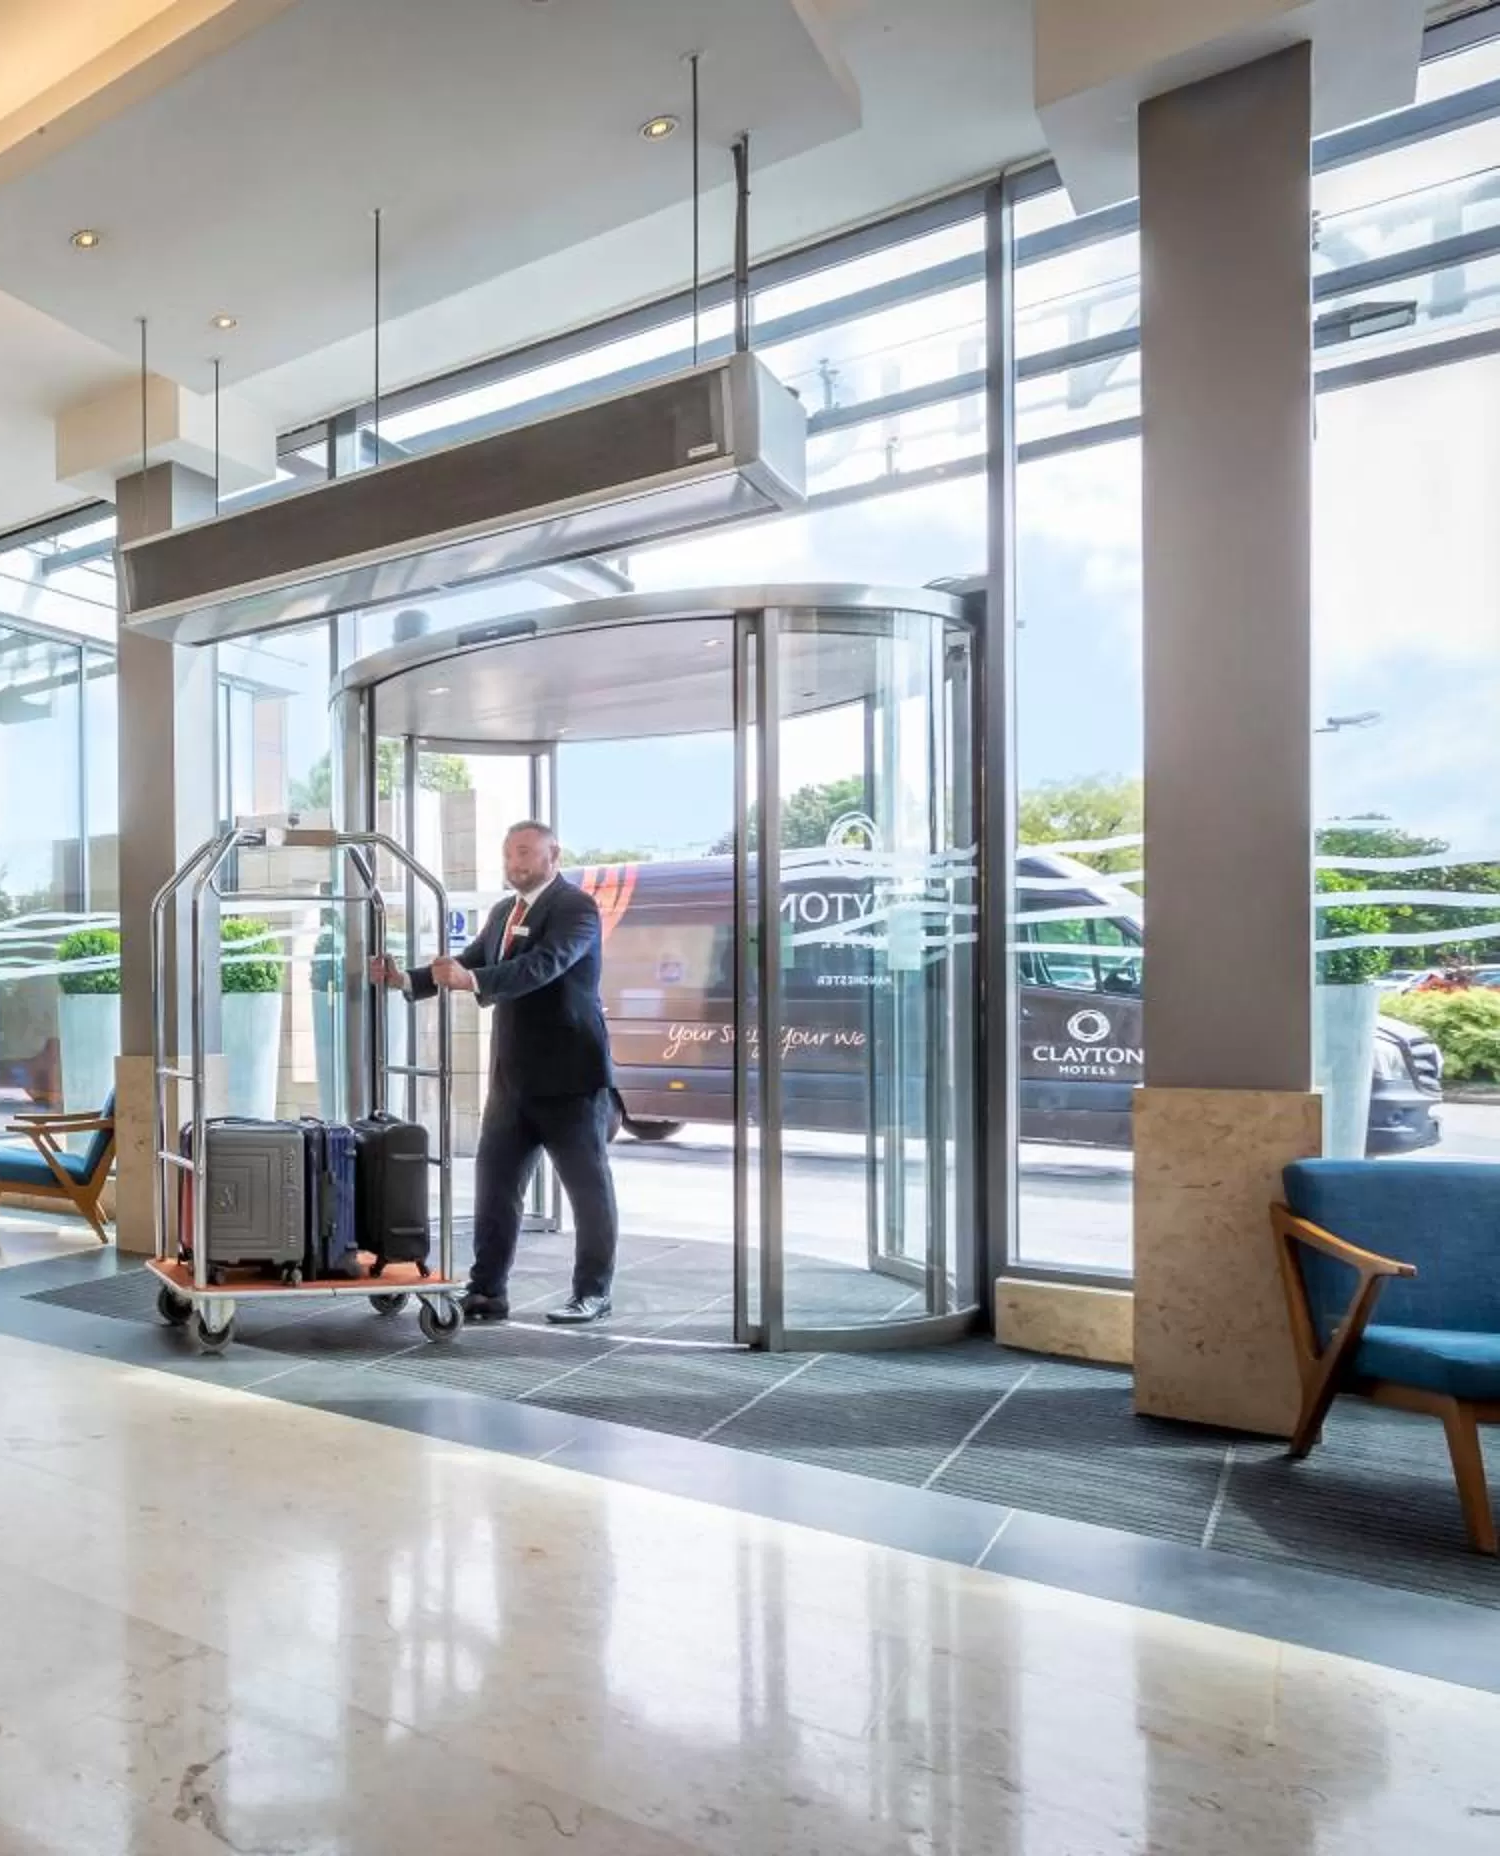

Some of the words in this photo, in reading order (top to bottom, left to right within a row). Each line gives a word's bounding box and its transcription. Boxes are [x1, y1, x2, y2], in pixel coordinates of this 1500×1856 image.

[663, 1023, 716, 1060] Your
[1032, 1046, 1144, 1064] CLAYTON
[1059, 1065, 1116, 1076] HOTELS
